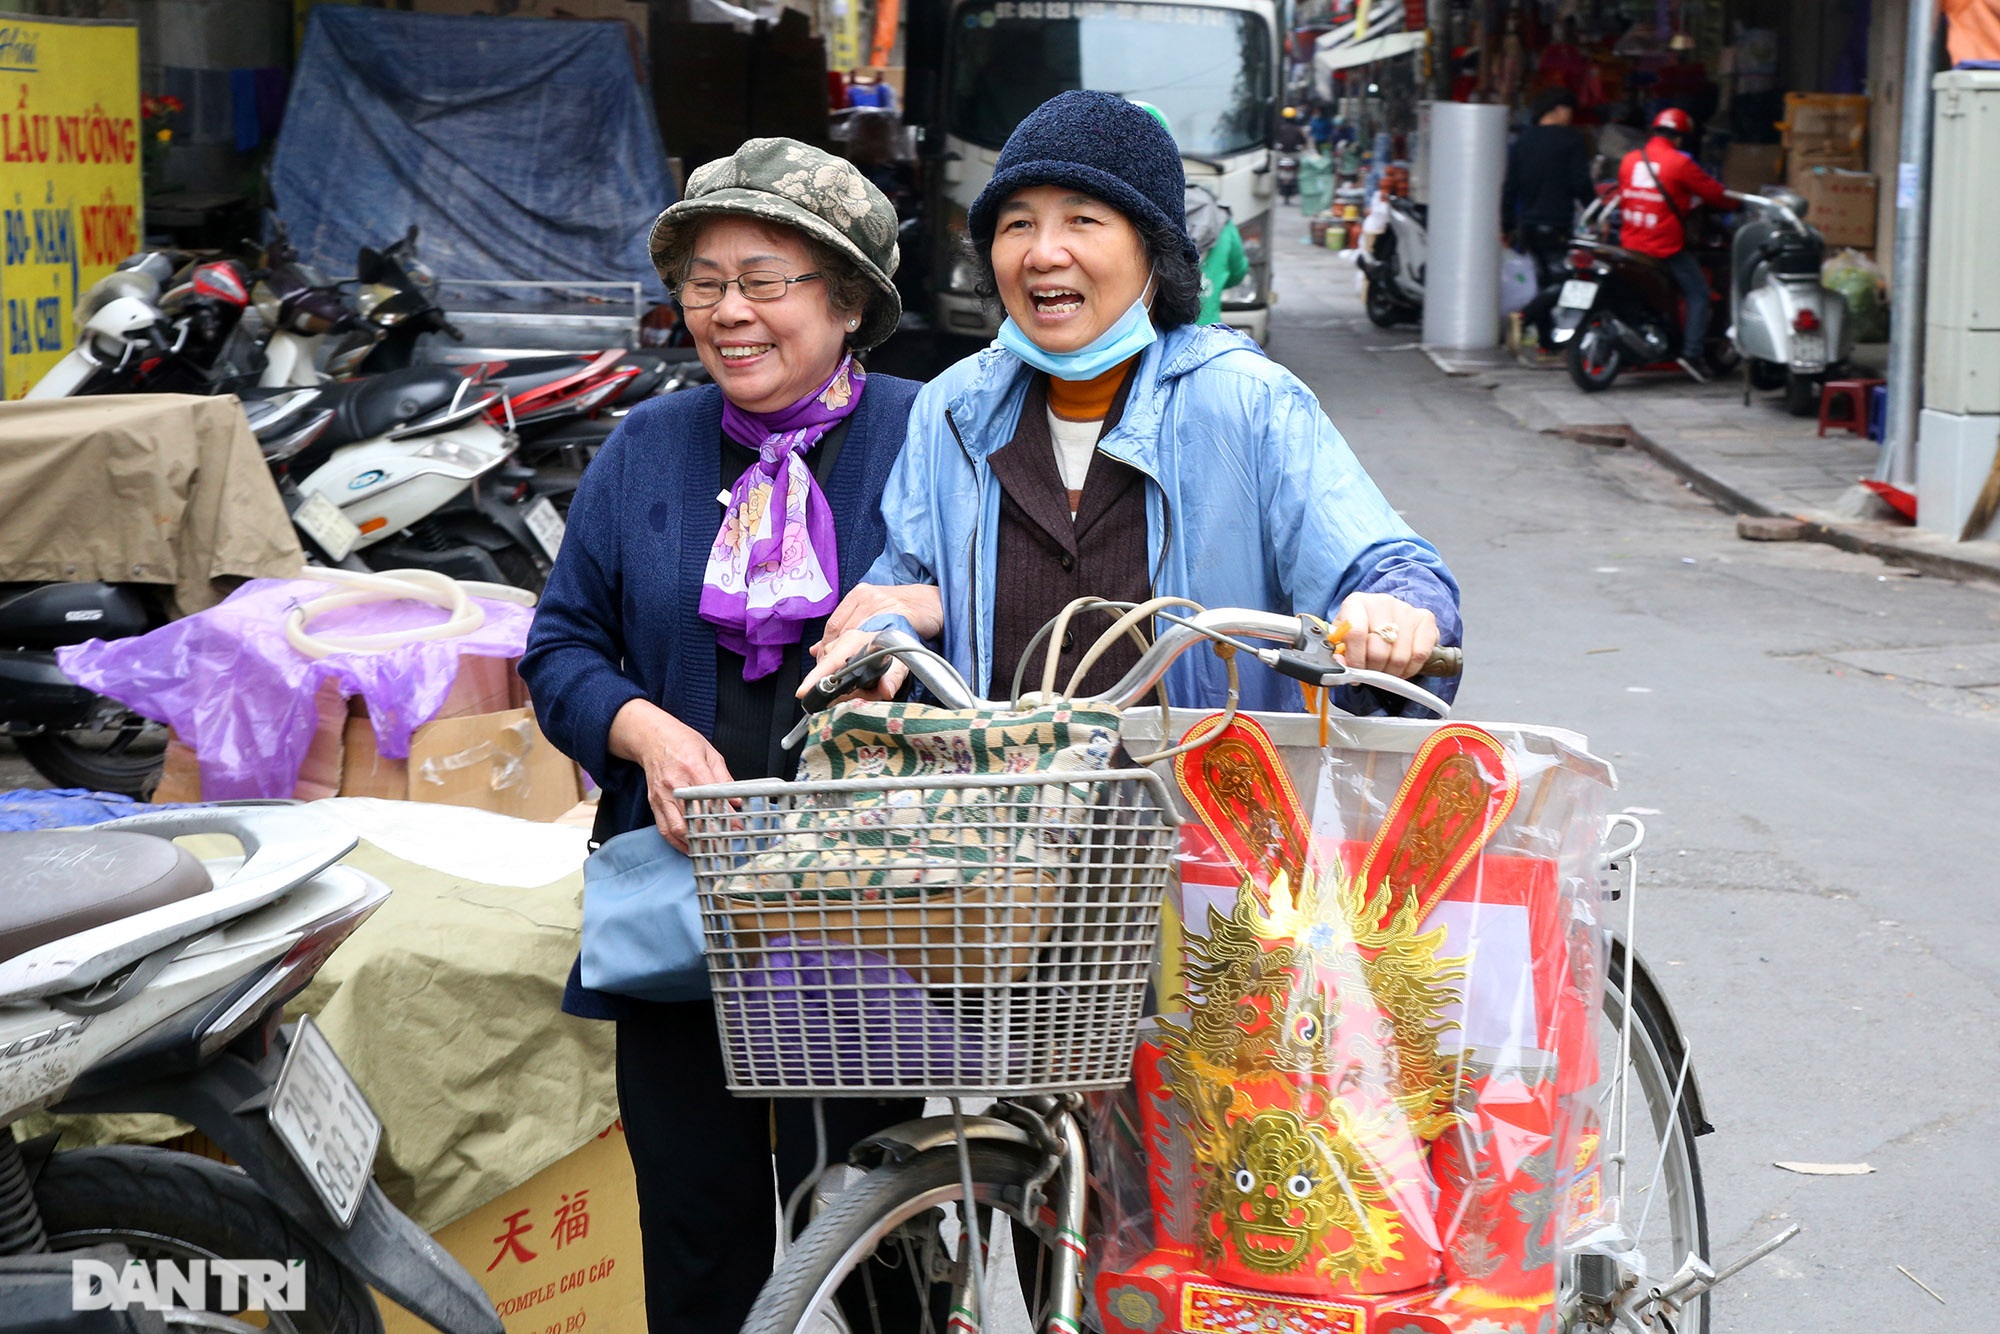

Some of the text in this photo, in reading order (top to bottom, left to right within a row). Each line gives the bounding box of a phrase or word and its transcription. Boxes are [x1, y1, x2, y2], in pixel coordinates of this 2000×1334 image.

[495, 1254, 616, 1319] COMPLE CAO CẤP
[565, 1305, 587, 1334] BỘ
